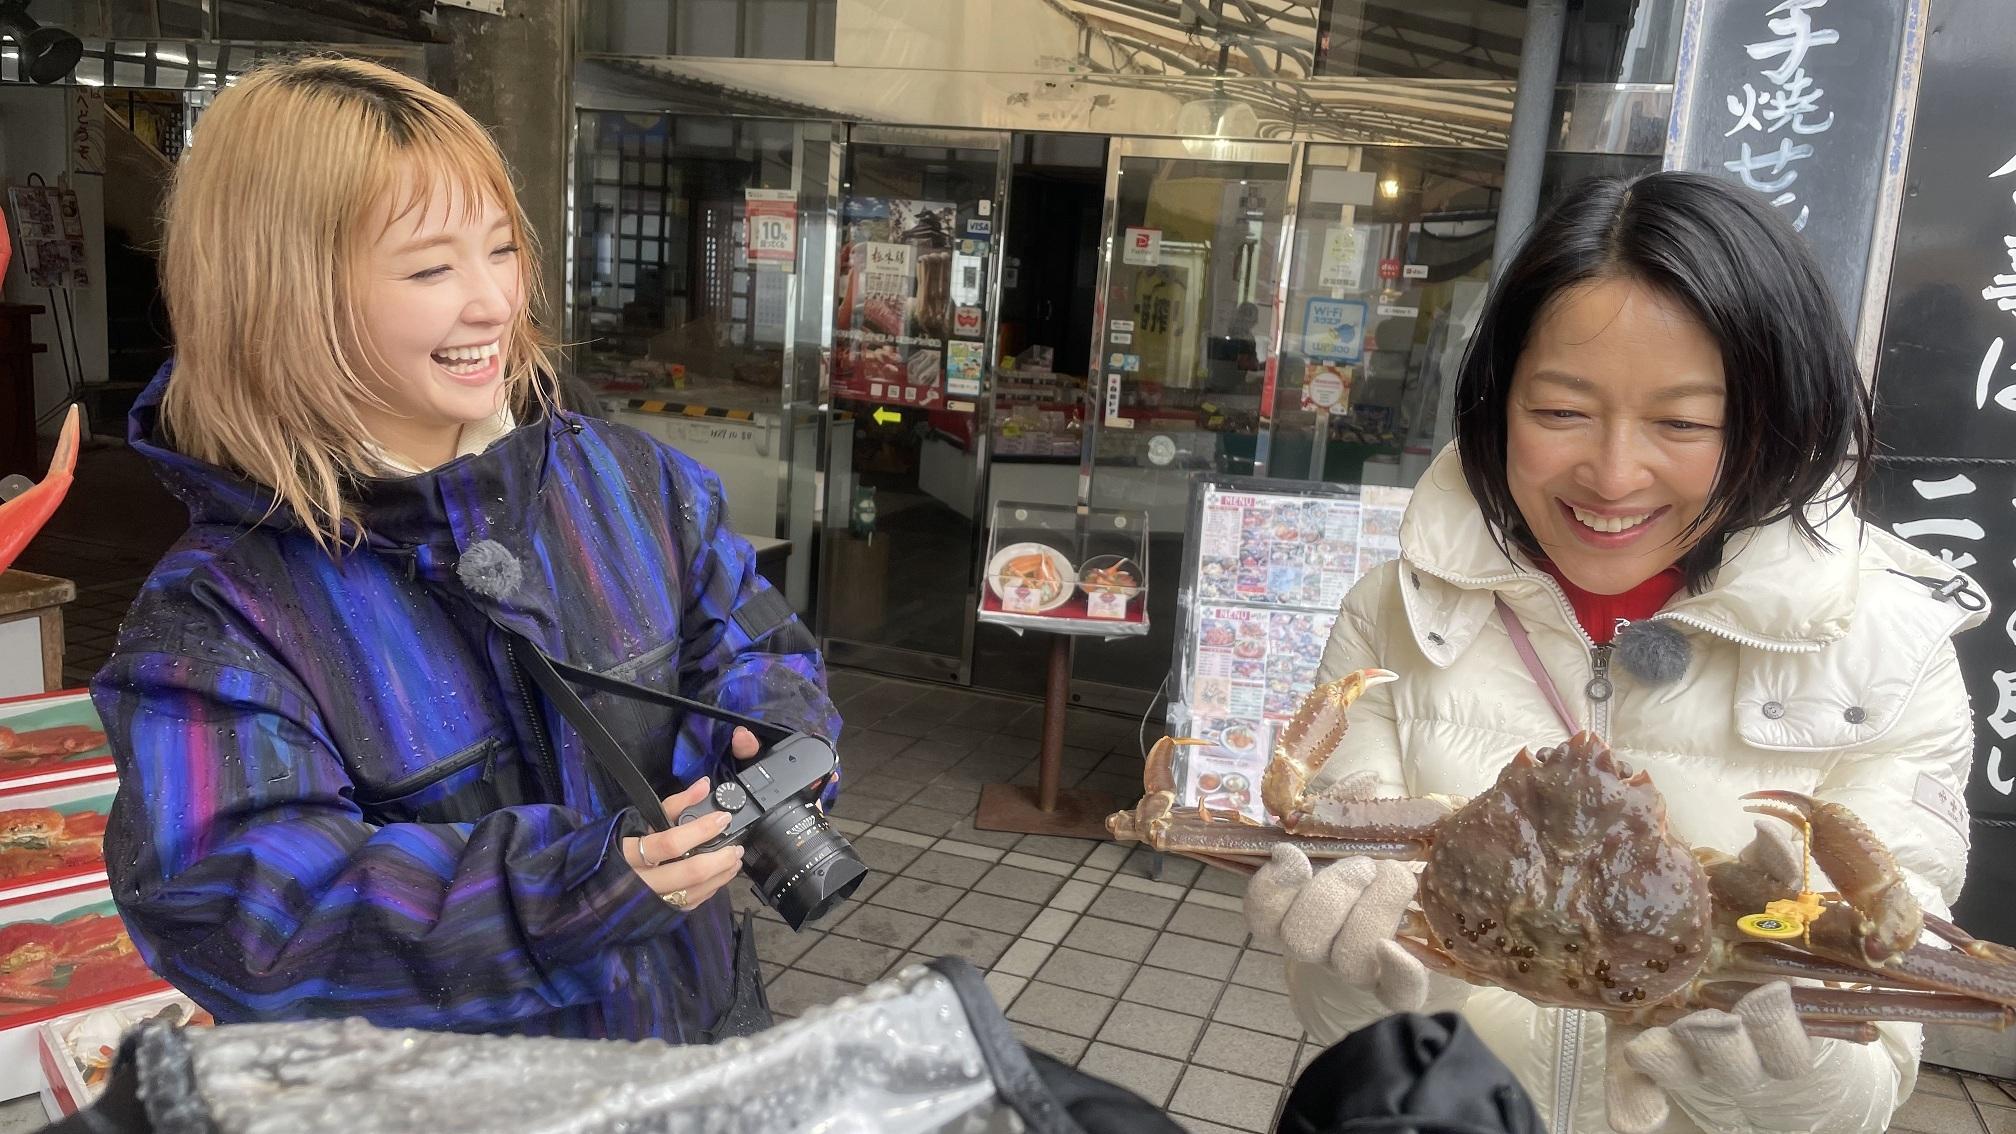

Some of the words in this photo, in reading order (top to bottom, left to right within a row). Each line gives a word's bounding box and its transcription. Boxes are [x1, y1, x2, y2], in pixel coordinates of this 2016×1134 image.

[969, 222, 989, 231] VISA
[1313, 305, 1343, 318] Wi-Fi
[1892, 473, 1985, 567] 二
